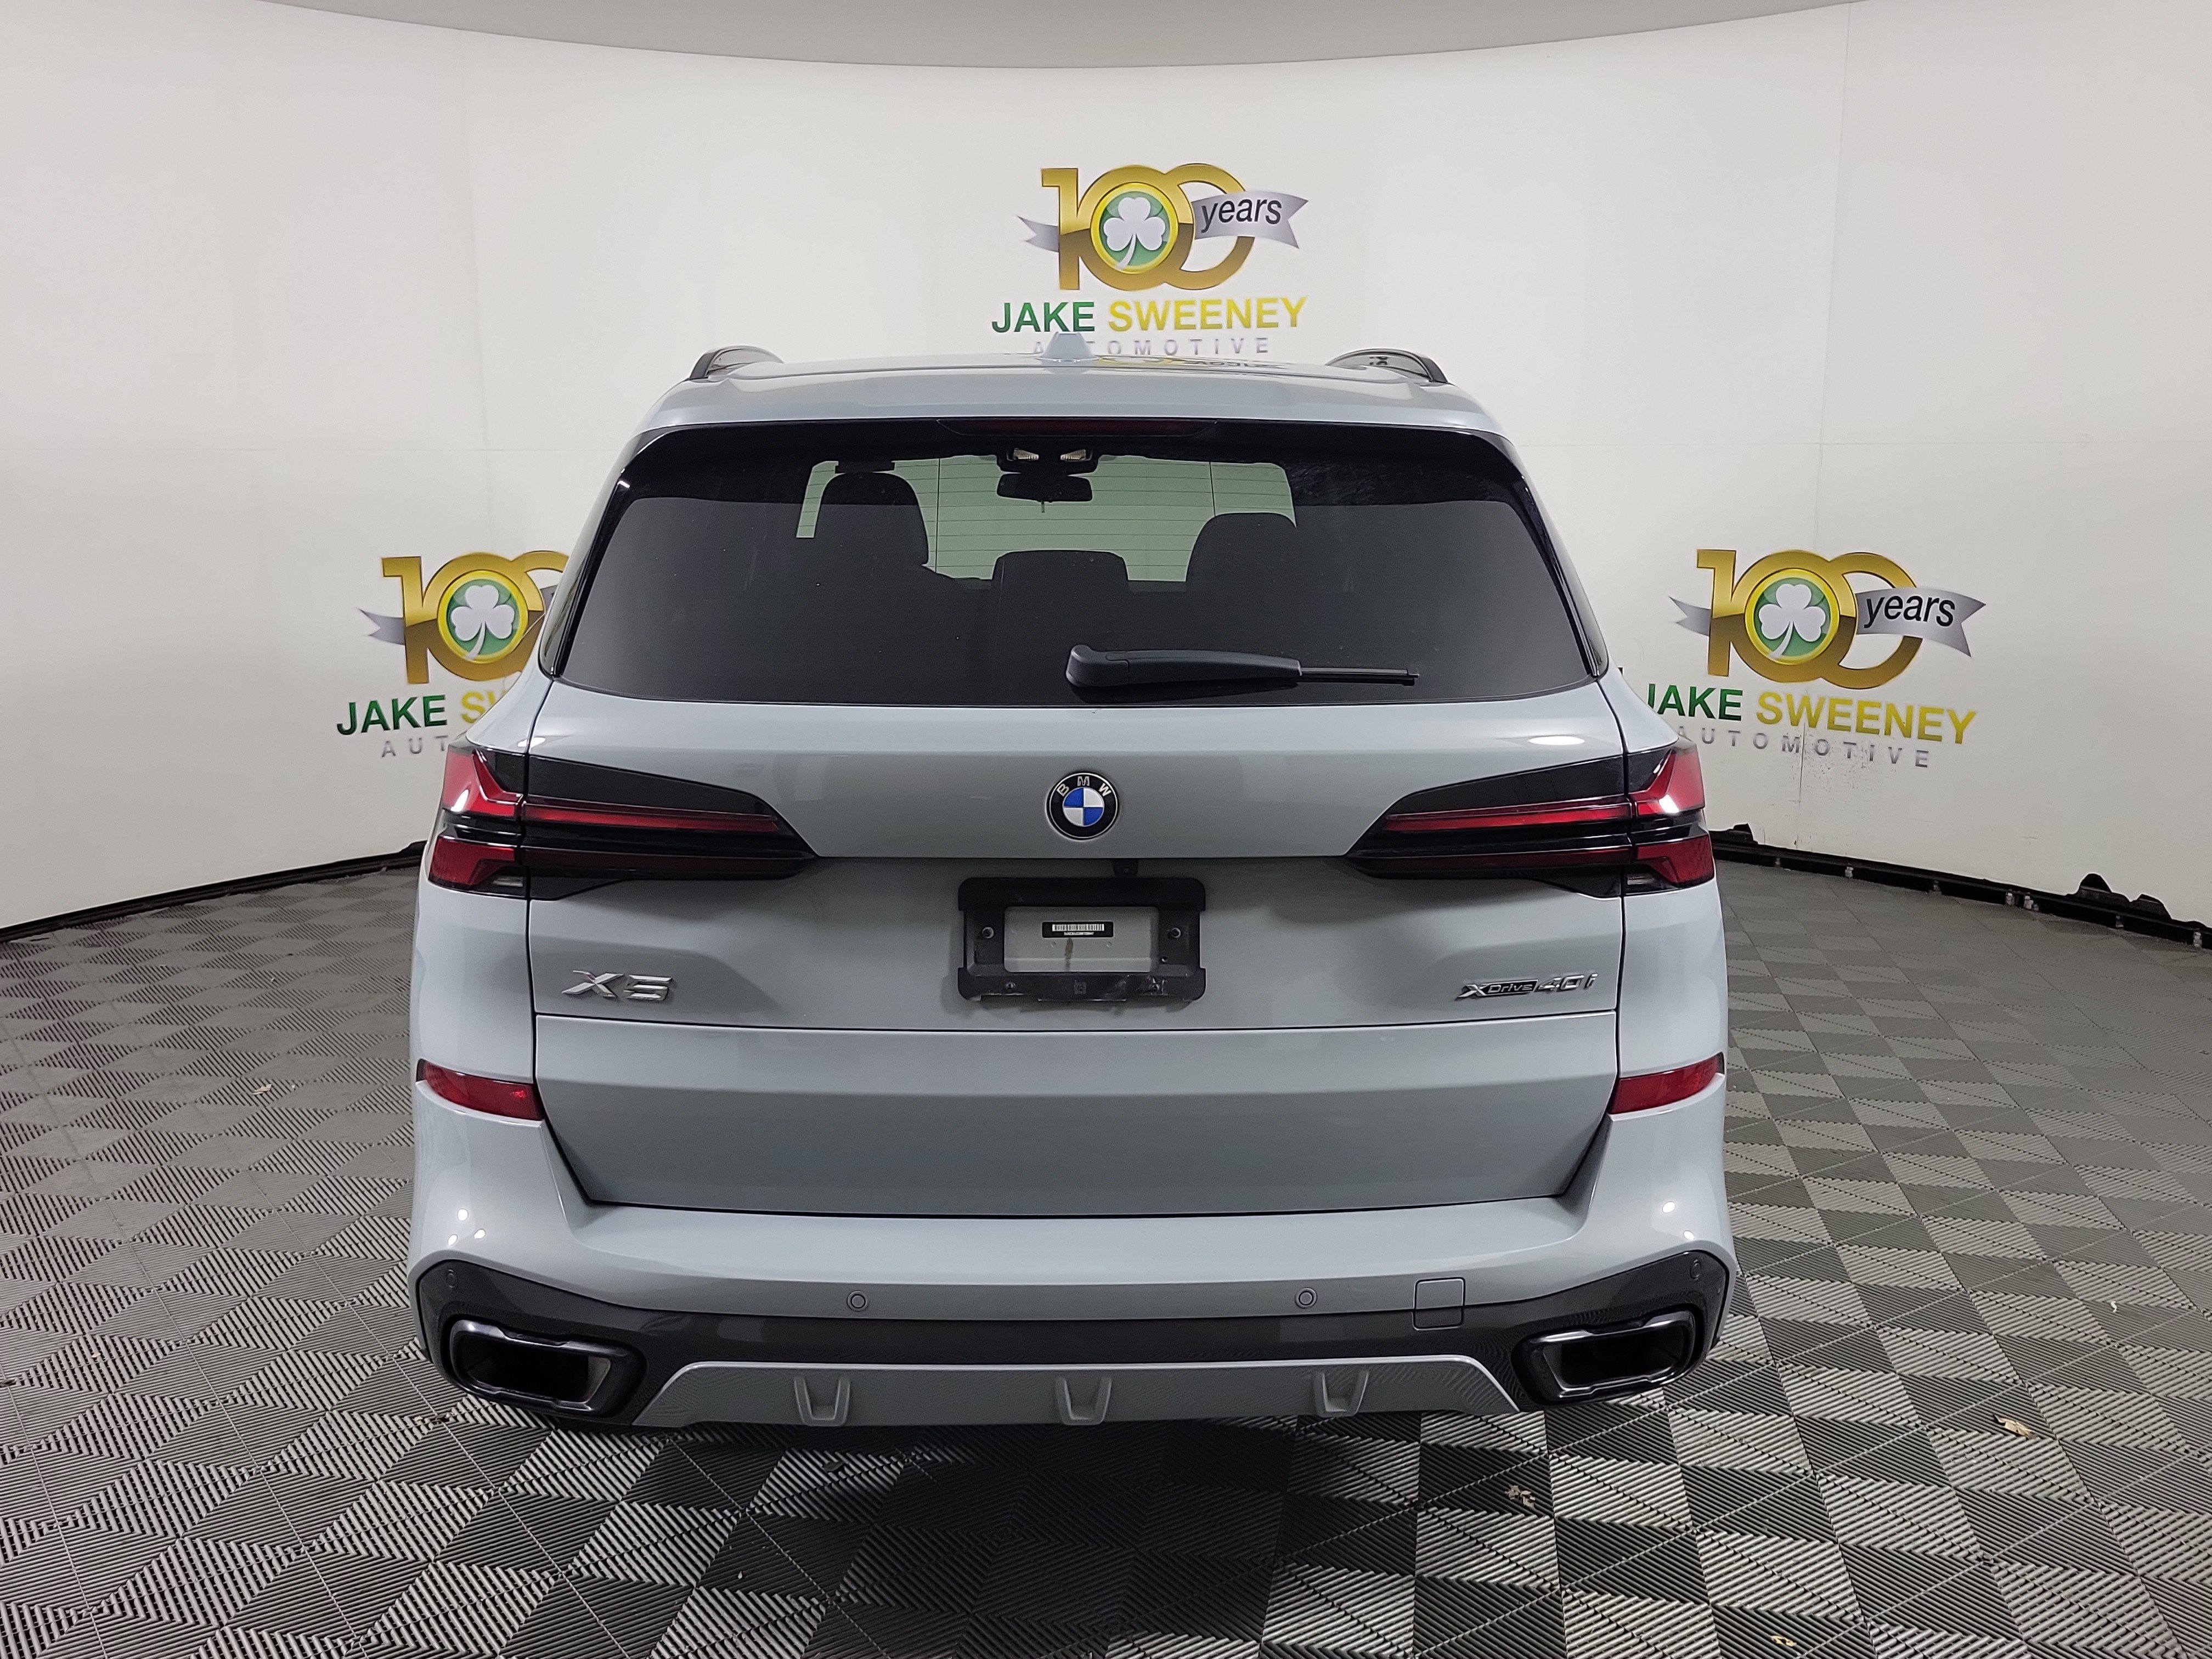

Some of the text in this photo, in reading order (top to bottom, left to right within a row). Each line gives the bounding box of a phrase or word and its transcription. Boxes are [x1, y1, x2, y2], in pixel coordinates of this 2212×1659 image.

[1041, 162, 1283, 291] 100 years
[991, 296, 1307, 333] JAKE SWEENEY
[1034, 337, 1268, 356] AOMOTIVE
[1696, 549, 1955, 690] 100 years
[336, 694, 448, 735] JAKE
[1756, 691, 1977, 744] SWEENEY
[1678, 726, 1929, 768] AUTOMOTIVE
[1056, 776, 1112, 797] BMW
[562, 970, 673, 1001] X5
